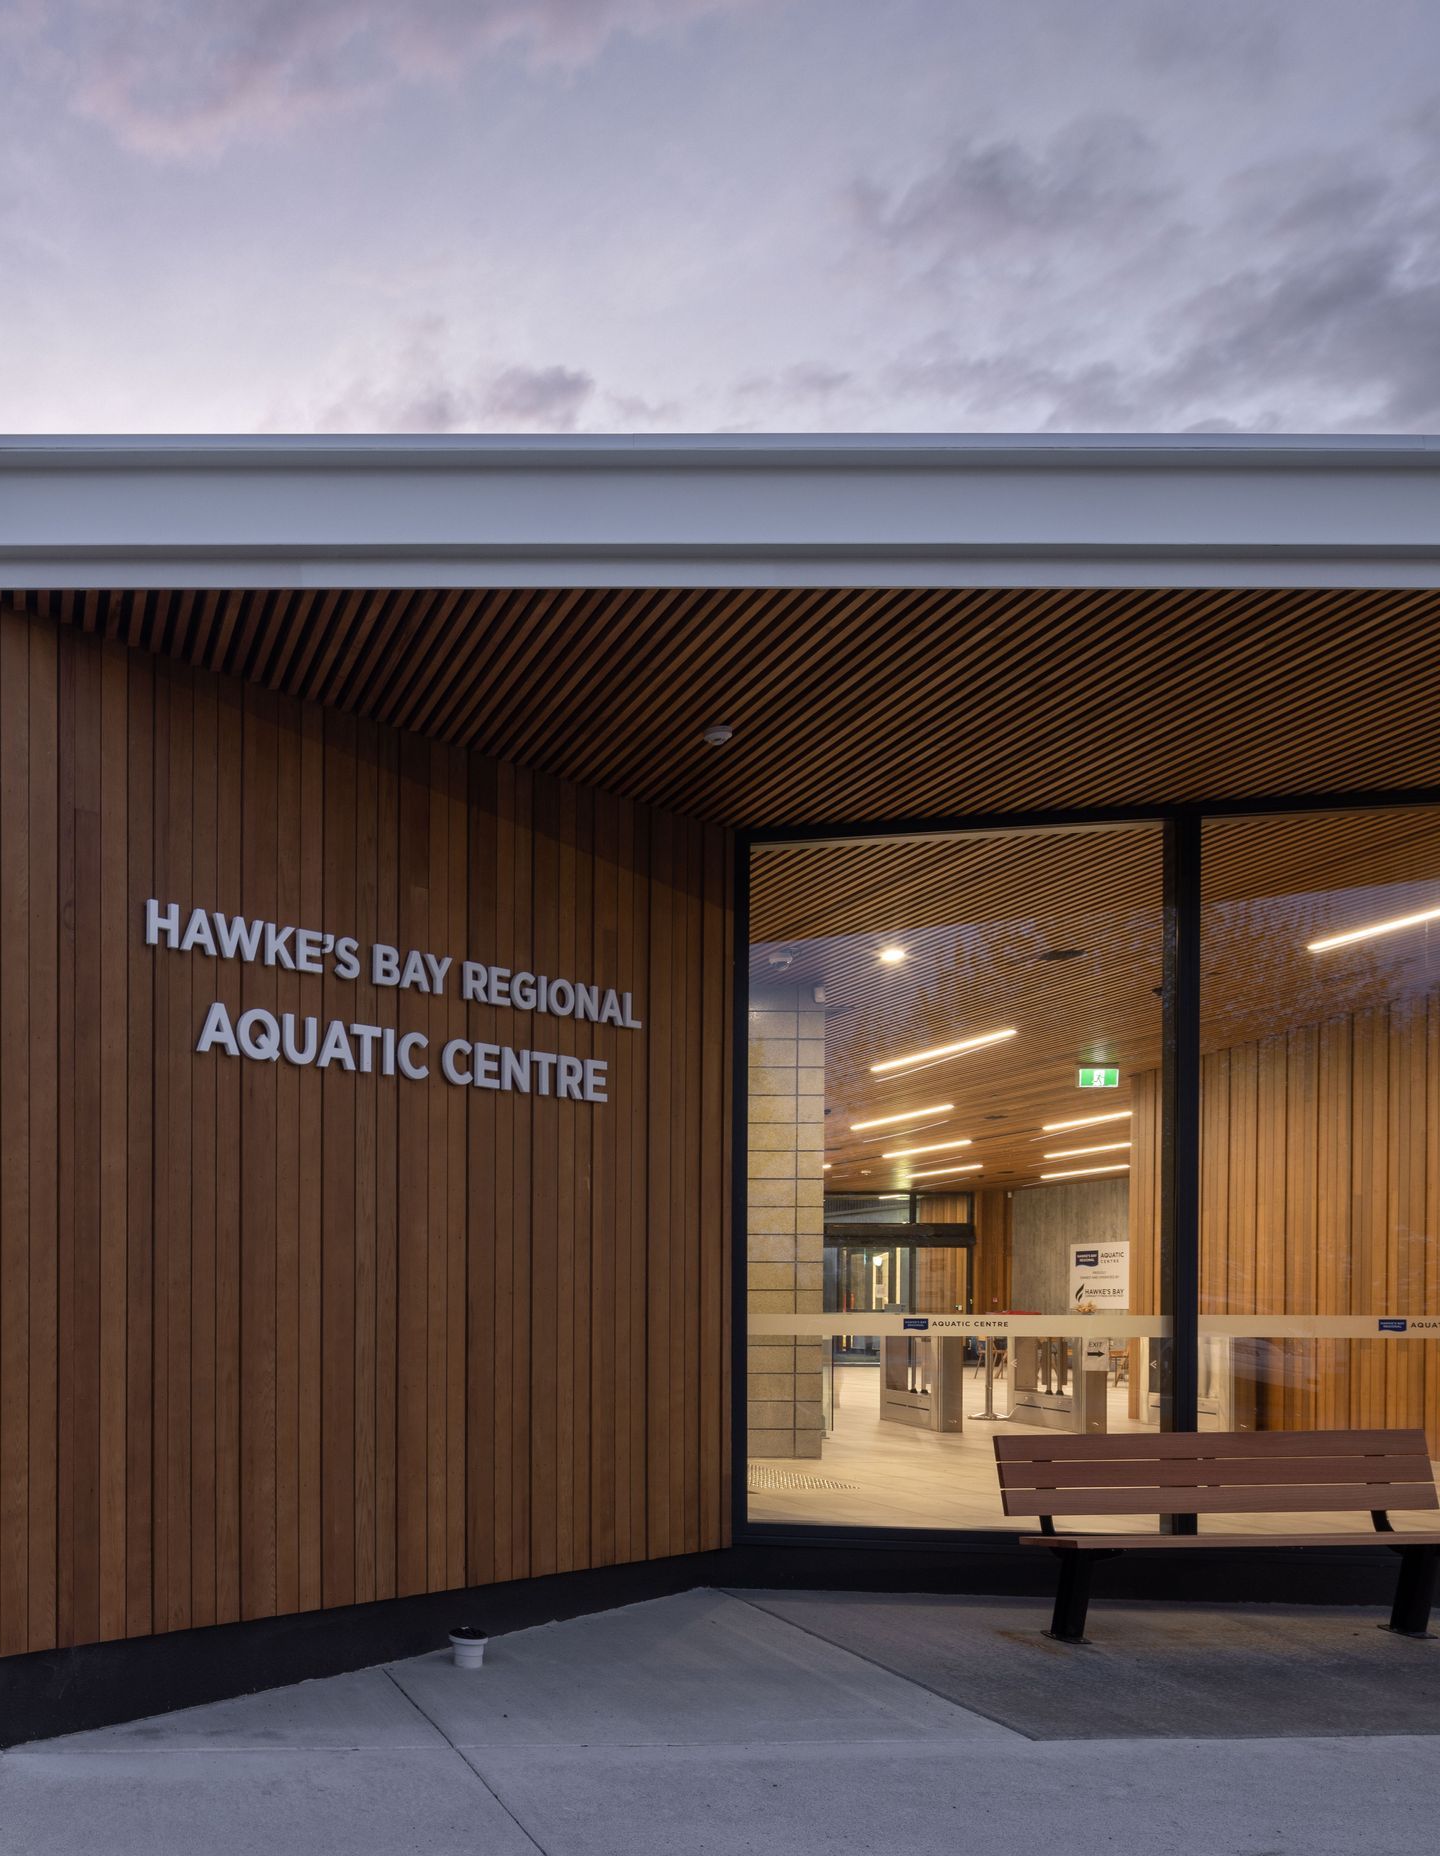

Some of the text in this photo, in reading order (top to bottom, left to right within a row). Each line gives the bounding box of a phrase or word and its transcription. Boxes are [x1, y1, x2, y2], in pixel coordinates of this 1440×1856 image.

[146, 898, 643, 1029] HAWKE’S BAY REGIONAL
[196, 1002, 609, 1103] AQUATIC CENTRE
